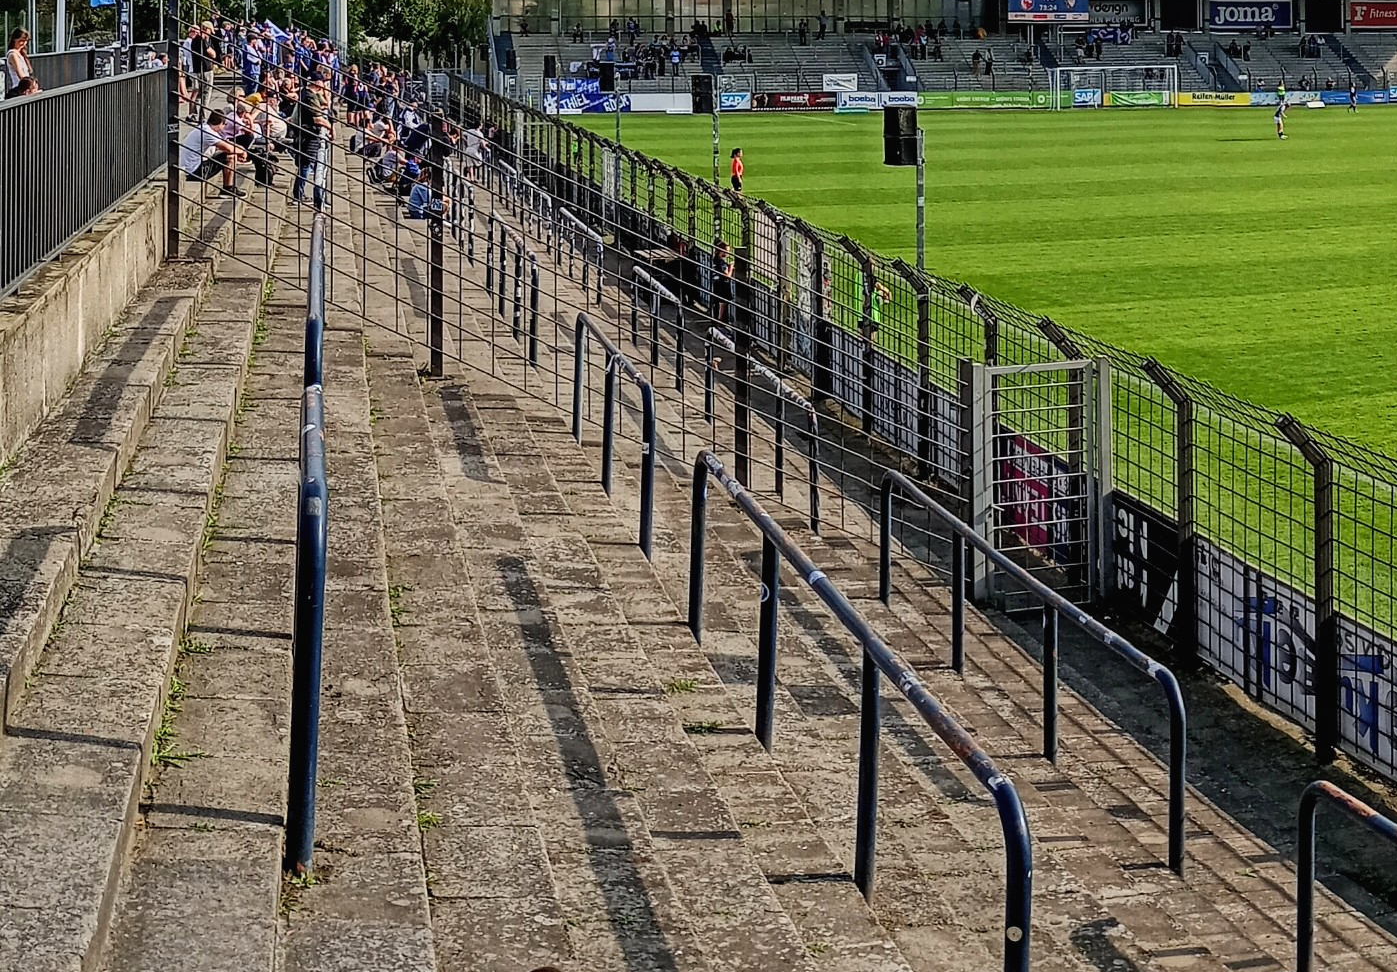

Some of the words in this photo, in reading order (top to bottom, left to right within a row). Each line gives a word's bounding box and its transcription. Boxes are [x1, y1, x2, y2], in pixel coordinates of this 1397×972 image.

[1075, 92, 1093, 102] SAP
[1192, 92, 1235, 100] Reifen-Müller
[1300, 93, 1316, 101] SAP
[721, 96, 742, 106] SAP
